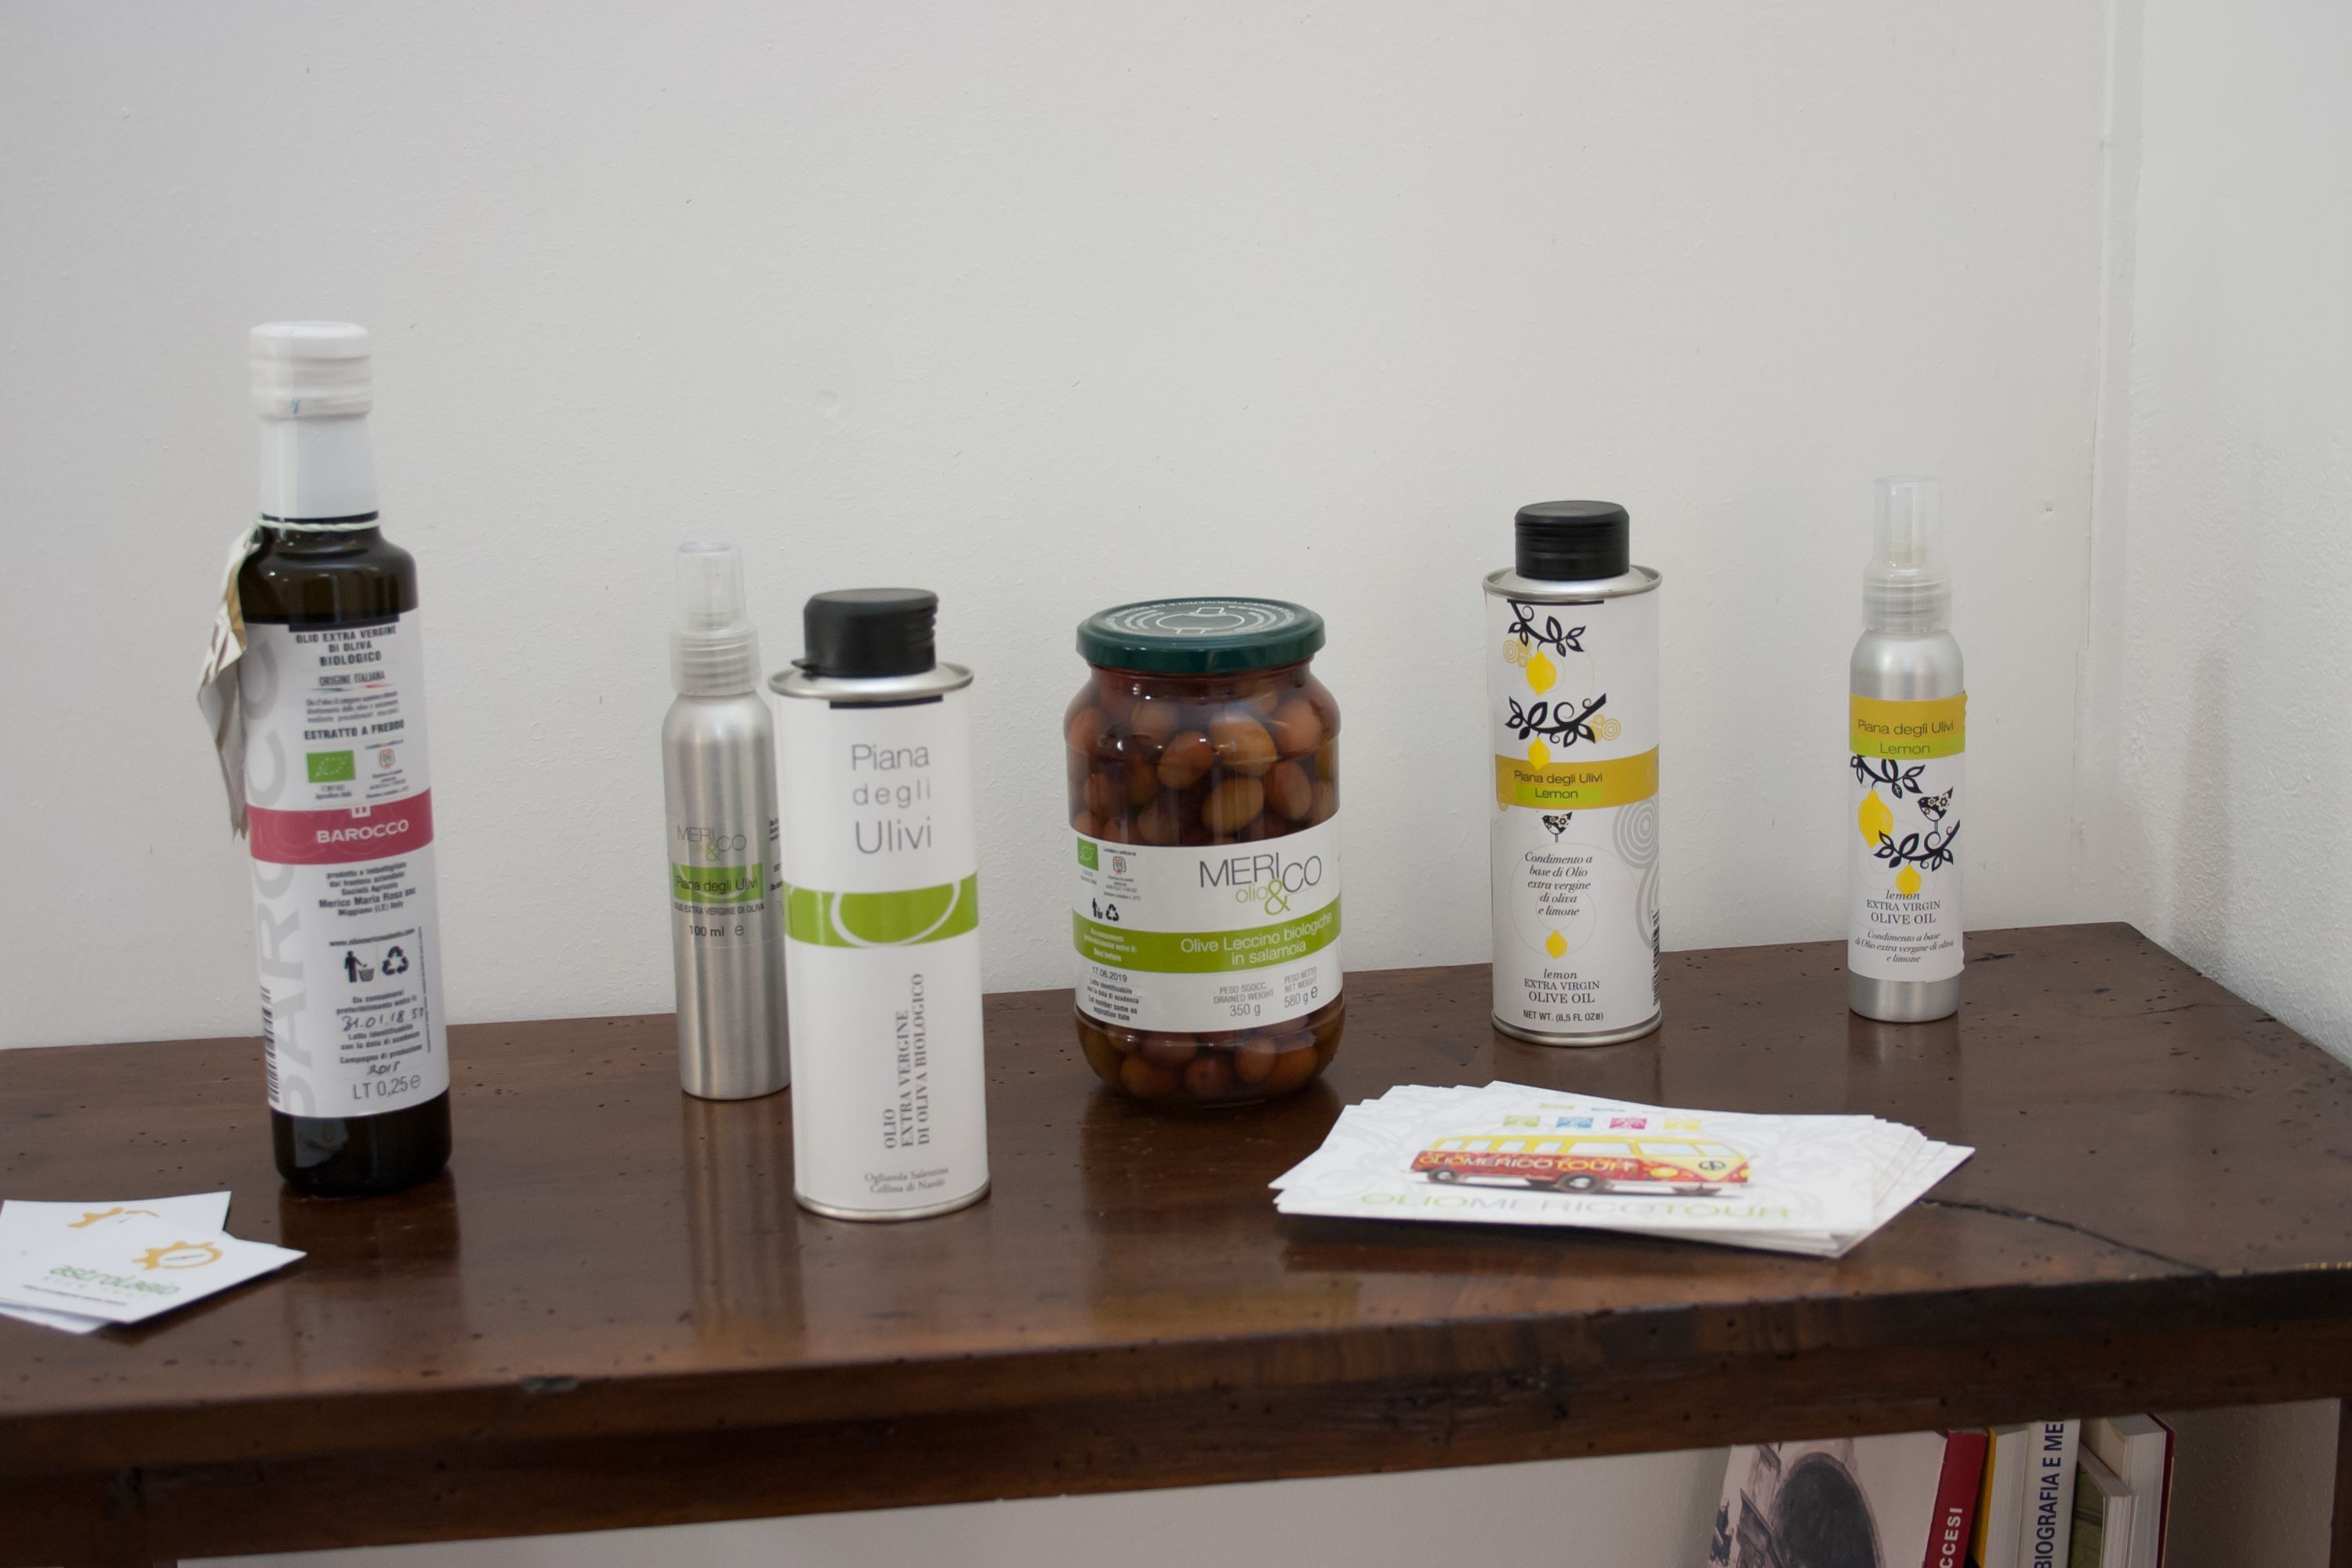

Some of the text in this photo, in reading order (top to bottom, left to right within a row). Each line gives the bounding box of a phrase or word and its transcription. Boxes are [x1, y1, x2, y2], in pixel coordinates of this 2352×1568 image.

[296, 625, 397, 643] OLIO EXTRA VERGINE
[328, 641, 372, 653] DI OLIVA
[319, 650, 382, 666] BIOLOGICO
[319, 670, 385, 686] ORIGINE ITALIANA
[304, 719, 405, 740] ESTRATTO A FREDDO
[1857, 719, 1954, 738] Piana degli Ulivi
[1880, 742, 1930, 755] Lemon
[851, 744, 930, 771] Piana
[1514, 770, 1602, 786] Piana degli Ulivi
[853, 778, 931, 809] degli
[1535, 788, 1578, 799] Lemon
[316, 819, 409, 844] BAROCCO
[677, 826, 747, 852] MERICO
[855, 816, 931, 855] Ulivi
[1525, 851, 1584, 864] Condimento
[1200, 852, 1322, 893] MERICO
[1529, 865, 1588, 877] base di Olio
[704, 879, 732, 895] degli
[735, 877, 758, 891] Ulivi
[1527, 880, 1592, 893] extra vergine
[319, 899, 351, 908] Merico
[354, 895, 380, 906] Maria
[1539, 892, 1577, 903] di oliva
[1886, 890, 1920, 900] lemon
[706, 906, 735, 916] VERGINE
[738, 905, 745, 913] DI
[746, 902, 765, 913] OLIVA
[1545, 906, 1581, 916] limone
[1866, 899, 1940, 911] EXTRA VIRGIN
[1871, 912, 1936, 925] OLIVE OIL
[690, 925, 724, 937] 100 ml
[1181, 912, 1332, 953] Olive Leccino biologiche
[1867, 930, 1915, 942] Condimento
[1923, 931, 1941, 940] base
[1232, 941, 1306, 965] in salamoia
[1855, 937, 1860, 946] di
[1861, 938, 1875, 949] Olio
[1899, 944, 1929, 955] vergine
[1929, 941, 1937, 951] di
[1893, 954, 1922, 963] limone
[1283, 966, 1317, 983] PESO NETTO
[1543, 968, 1577, 979] lemon
[1219, 984, 1239, 994] PESO
[1284, 975, 1317, 993] NET WEIGHT
[1524, 978, 1600, 990] EXTRA VIRGIN
[1114, 993, 1139, 1004] scadenza
[1213, 989, 1274, 1004] DRAINED WEIGHT
[1283, 991, 1308, 1008] 580 g
[1529, 991, 1595, 1004] OLIVE OIL
[1114, 1004, 1128, 1012] same
[1229, 1003, 1261, 1017] 350 g
[1523, 1009, 1537, 1019] NET
[1538, 1011, 1554, 1021] WT.
[911, 973, 930, 1145] DI OLIVA BIOLOGICO
[896, 1010, 914, 1147] EXTRA VERGINE
[353, 1082, 371, 1099] LT
[883, 1108, 897, 1149] OLIO
[906, 1181, 916, 1191] di
[1359, 1192, 1790, 1220] OLIOMERICOTOUR
[2034, 1424, 2063, 1567] BIOGRAFIA E ME
